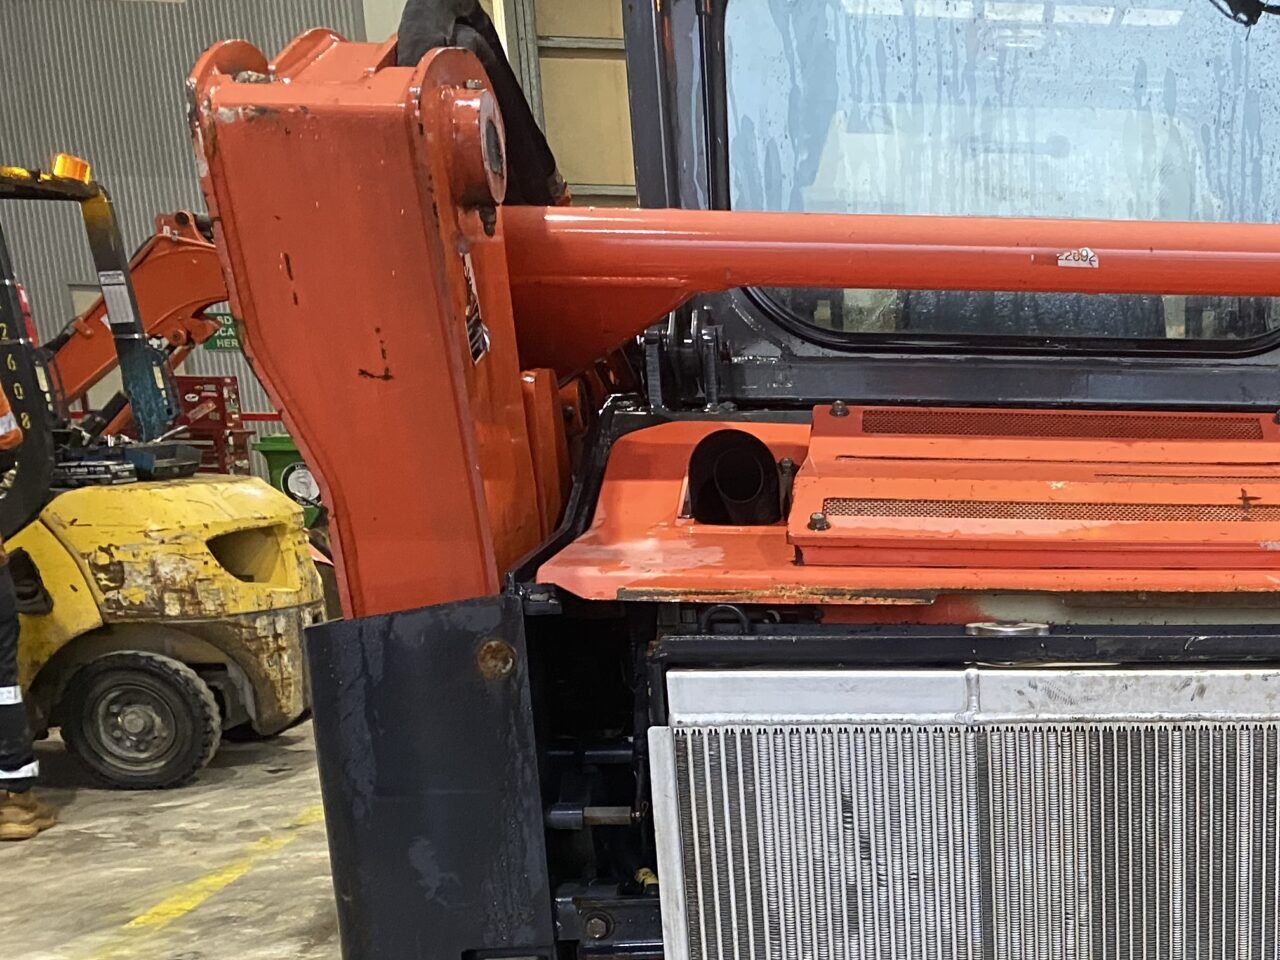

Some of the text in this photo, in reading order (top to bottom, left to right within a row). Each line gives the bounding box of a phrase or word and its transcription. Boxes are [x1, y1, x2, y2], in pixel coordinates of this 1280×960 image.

[216, 315, 233, 325] SD
[214, 327, 236, 337] CA
[216, 338, 240, 348] HER
